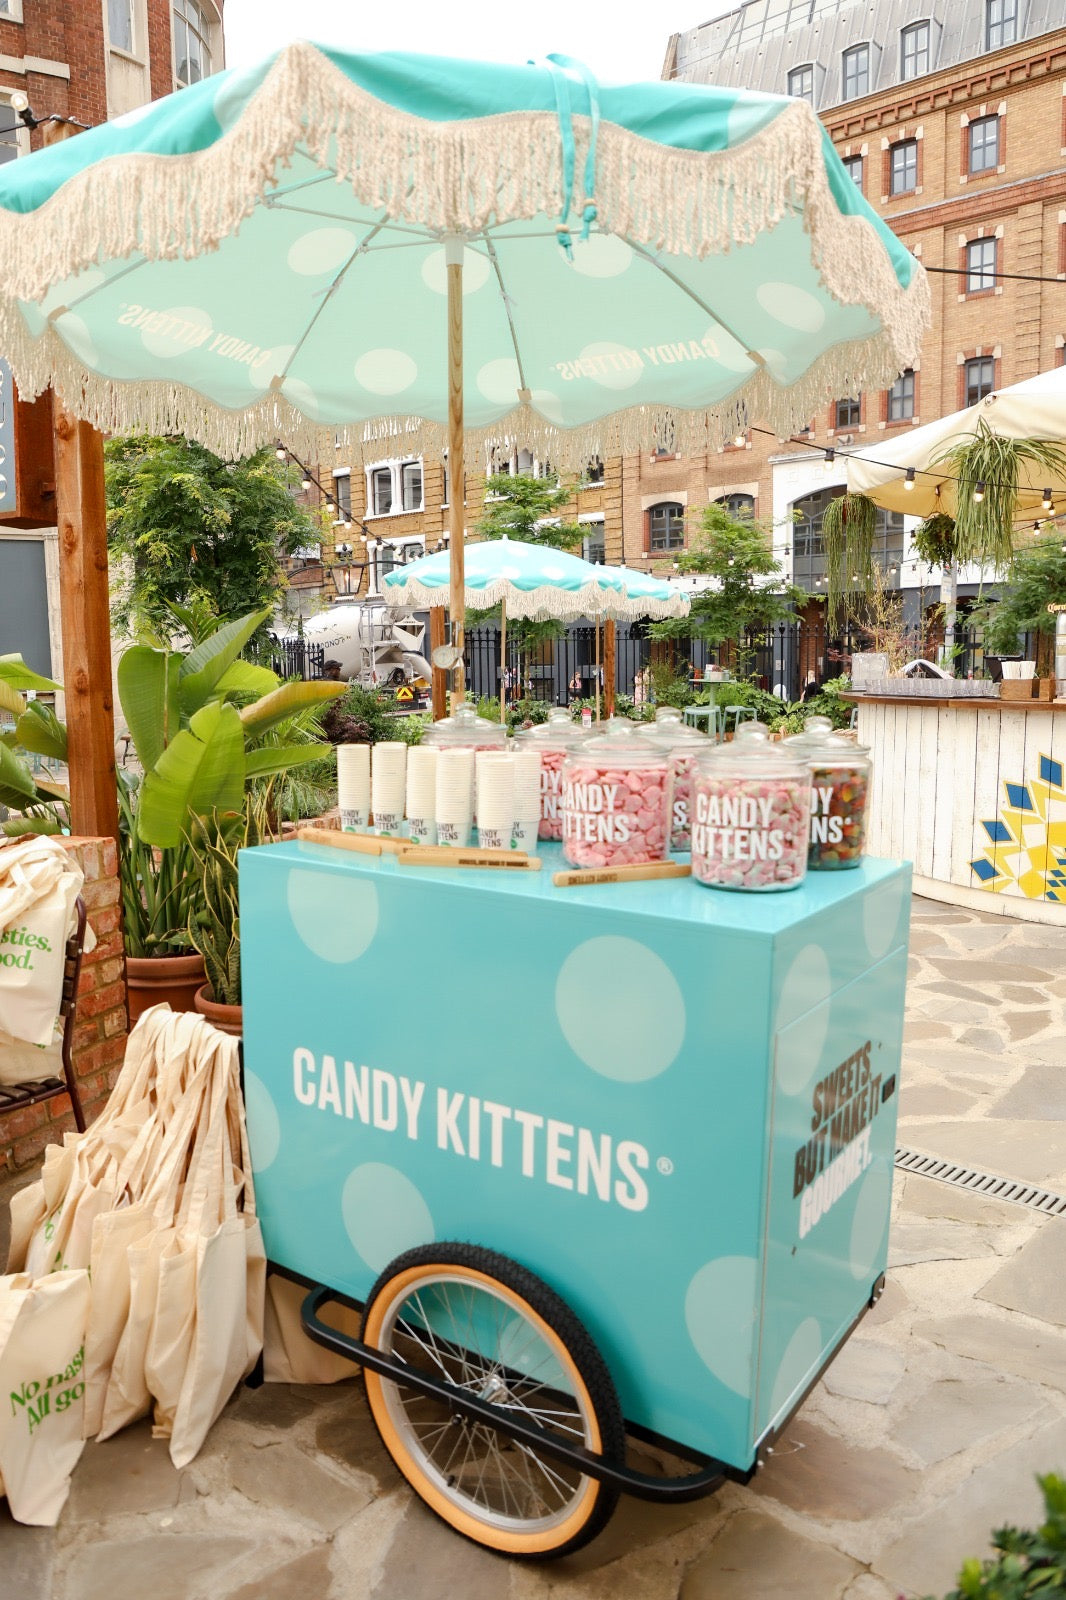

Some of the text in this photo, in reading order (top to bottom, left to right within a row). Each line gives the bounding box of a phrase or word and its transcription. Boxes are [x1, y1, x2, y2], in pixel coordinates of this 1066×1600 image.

[562, 810, 630, 843] ITTENS
[697, 793, 773, 828] CANDY
[292, 1047, 425, 1141] CANDY
[793, 1072, 882, 1199] BUT MAKE IT
[10, 1381, 40, 1417] No
[27, 1391, 50, 1435] All
